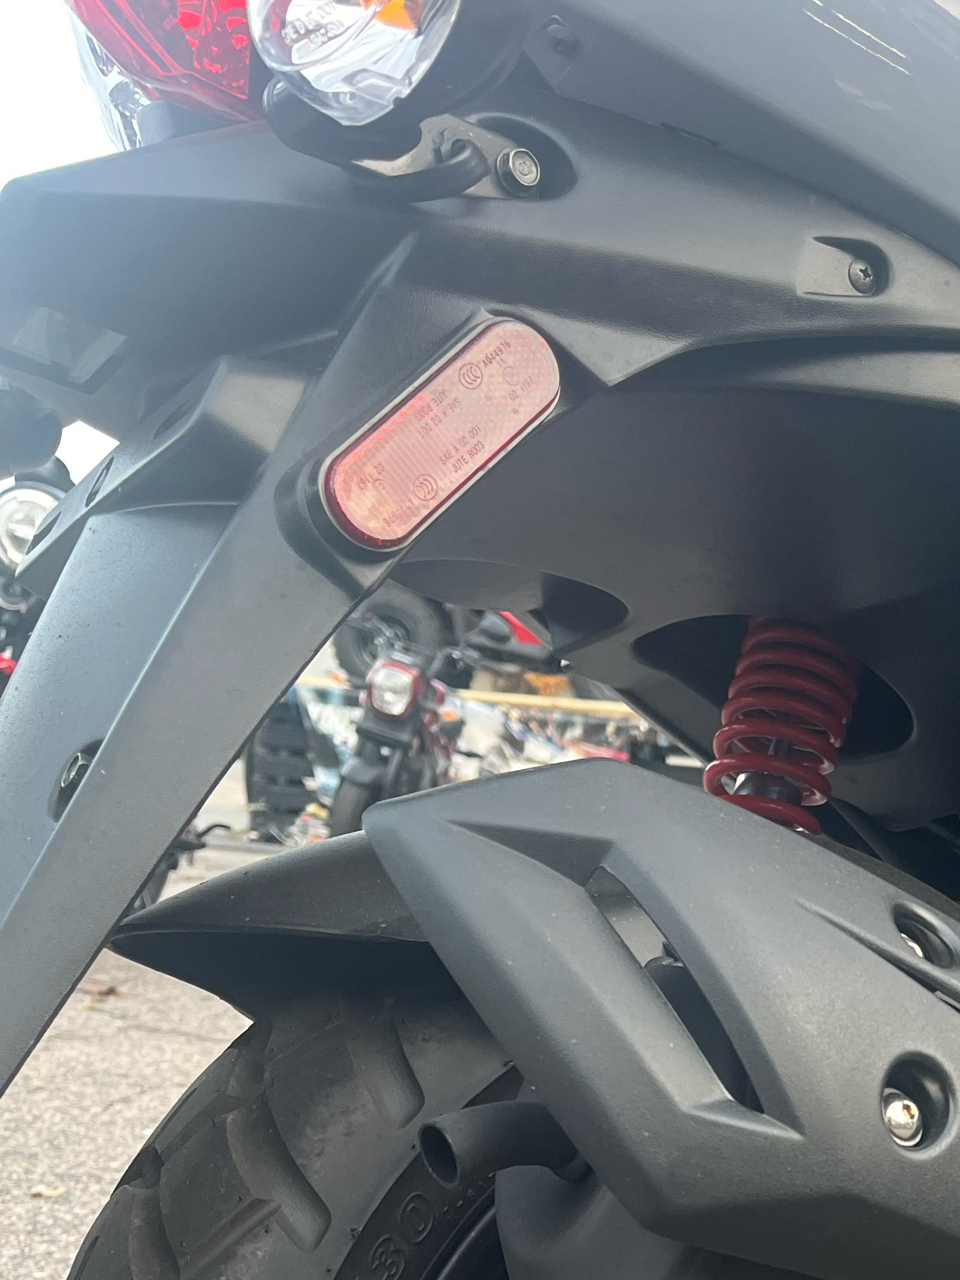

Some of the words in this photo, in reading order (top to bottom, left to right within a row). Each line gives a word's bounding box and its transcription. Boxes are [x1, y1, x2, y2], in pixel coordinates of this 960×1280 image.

[439, 450, 454, 466] SAE
[460, 435, 471, 449] 02
[451, 455, 470, 474] JUTE
[467, 440, 485, 460] R003
